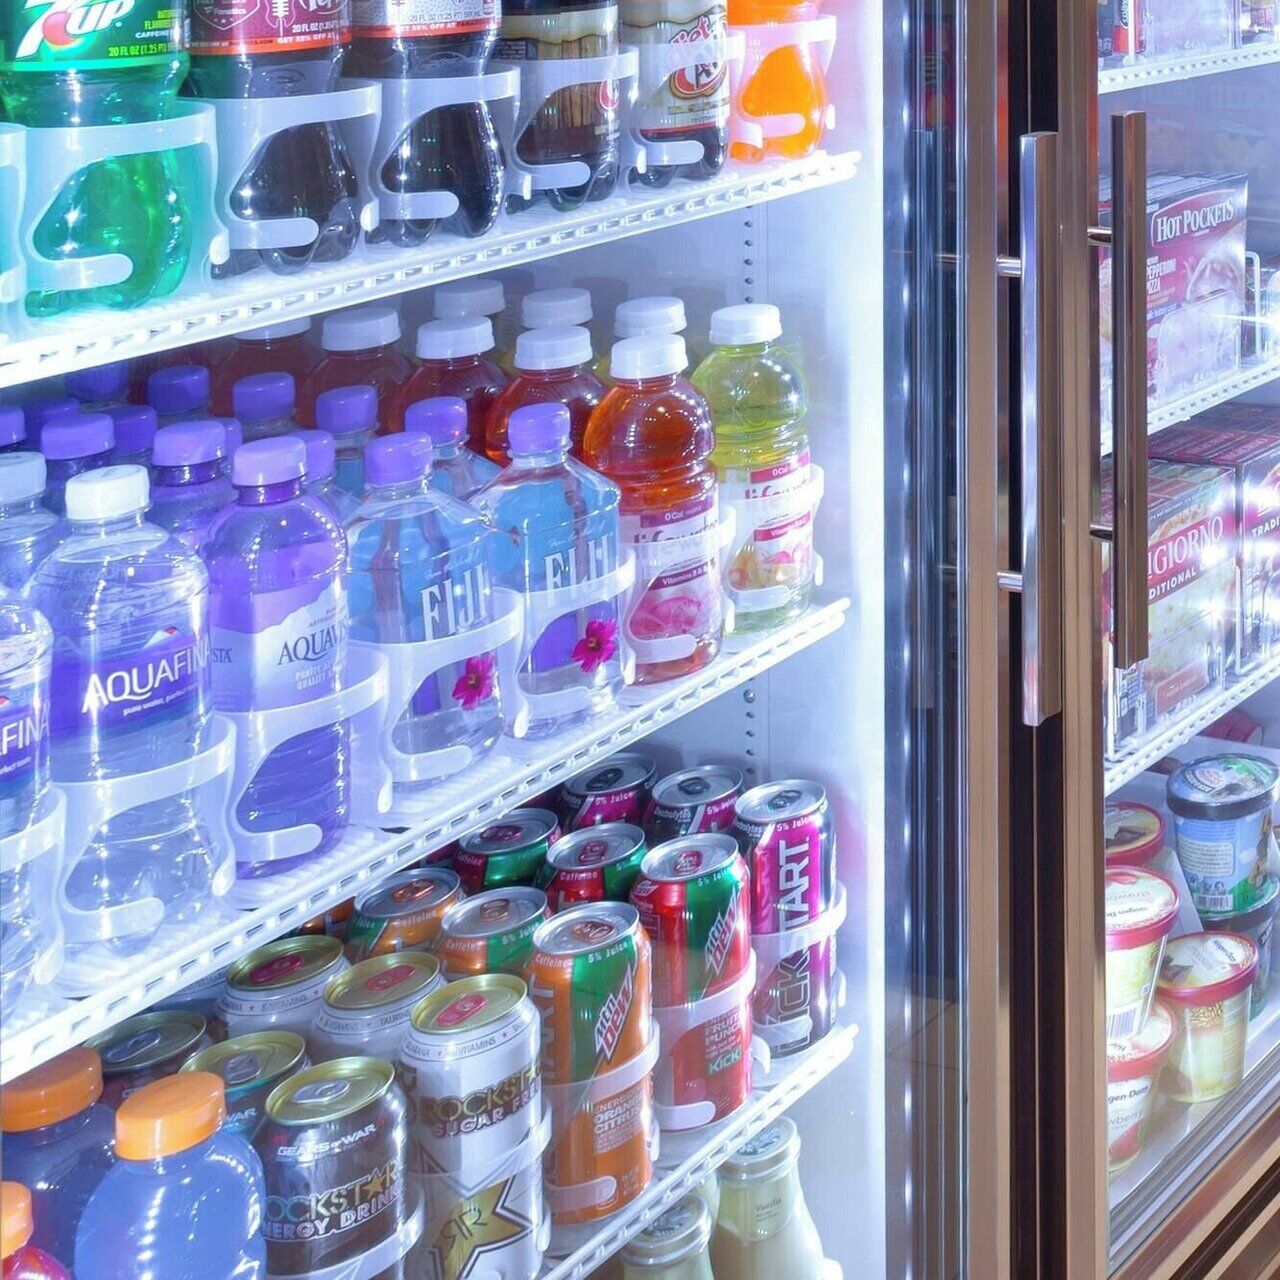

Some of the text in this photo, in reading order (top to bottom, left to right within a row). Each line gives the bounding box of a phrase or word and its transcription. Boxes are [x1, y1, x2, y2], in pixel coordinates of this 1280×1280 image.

[1157, 198, 1234, 243] HOT POCKETS
[542, 532, 612, 607] FIJI
[420, 563, 488, 642] FIJI
[610, 791, 634, 804] Juice
[776, 823, 790, 832] 5%
[560, 871, 598, 881] Caffeine
[445, 922, 541, 951] Caffeine 5% Juice
[535, 942, 628, 968] Caffeine 5% Juice
[709, 1050, 742, 1074] KICK
[342, 1124, 376, 1144] WAR
[434, 1110, 504, 1137] SUGAR
